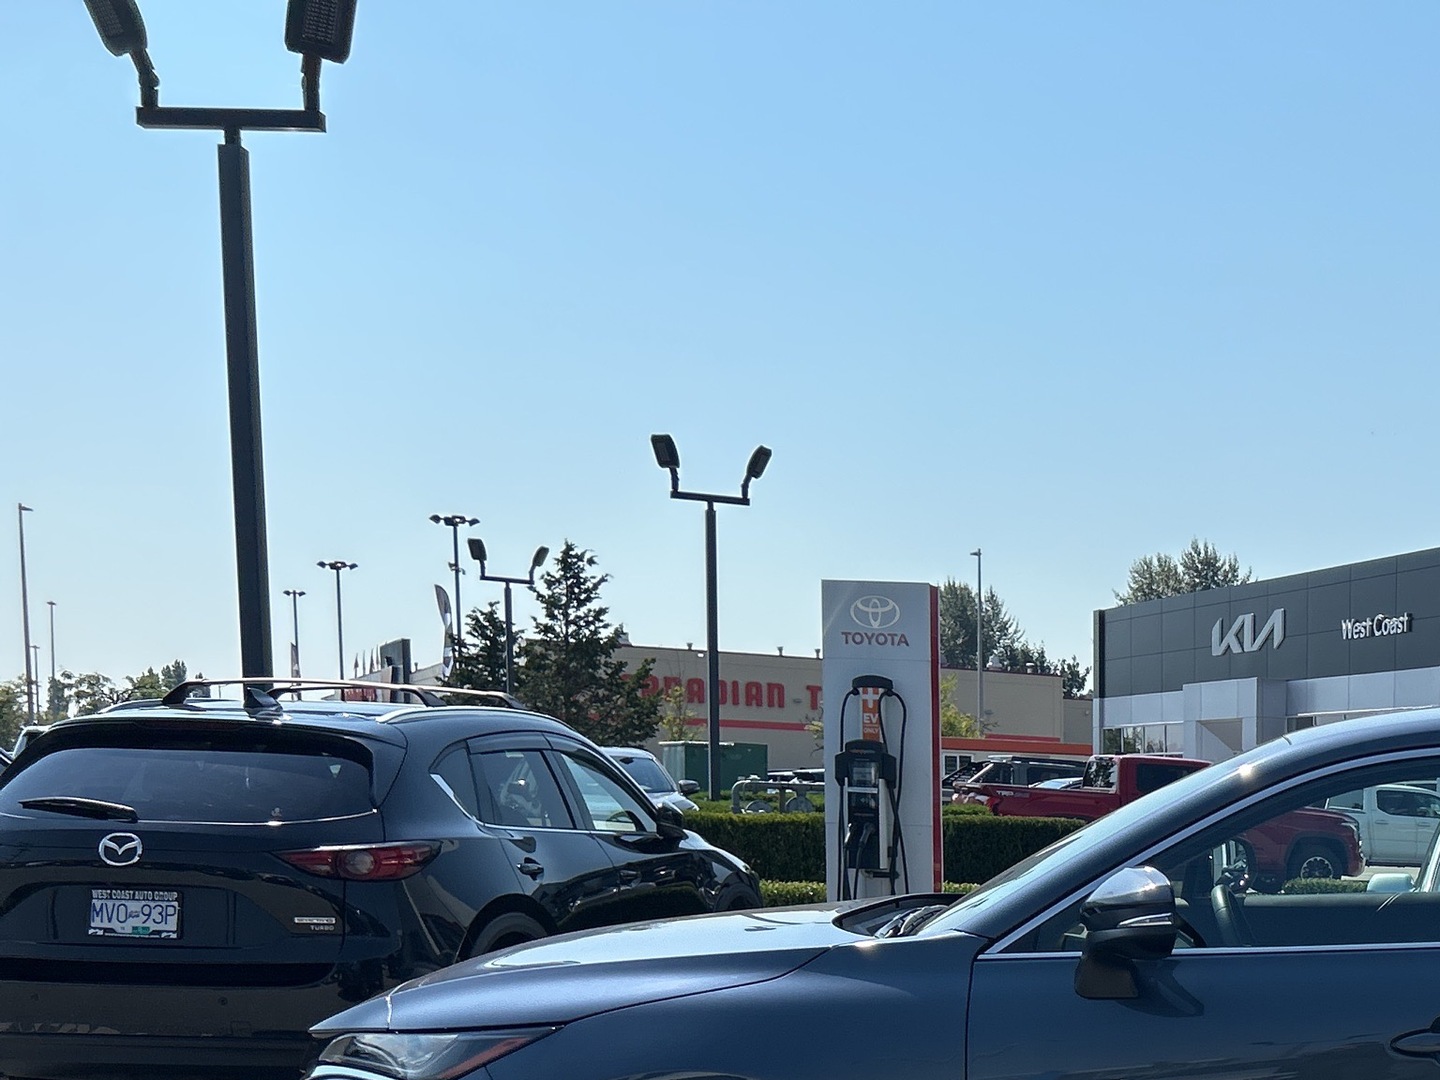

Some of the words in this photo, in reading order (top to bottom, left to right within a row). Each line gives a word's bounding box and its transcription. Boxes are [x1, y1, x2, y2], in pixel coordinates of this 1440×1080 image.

[1211, 608, 1284, 656] KIA
[1341, 618, 1372, 641] West
[1373, 612, 1410, 637] Coast
[841, 631, 910, 647] TOYOTA
[863, 713, 879, 724] EV
[92, 889, 111, 899] WEST
[112, 890, 133, 899] COAST
[135, 891, 153, 900] AUTO
[154, 892, 178, 900] GROUP
[141, 903, 176, 925] 93P
